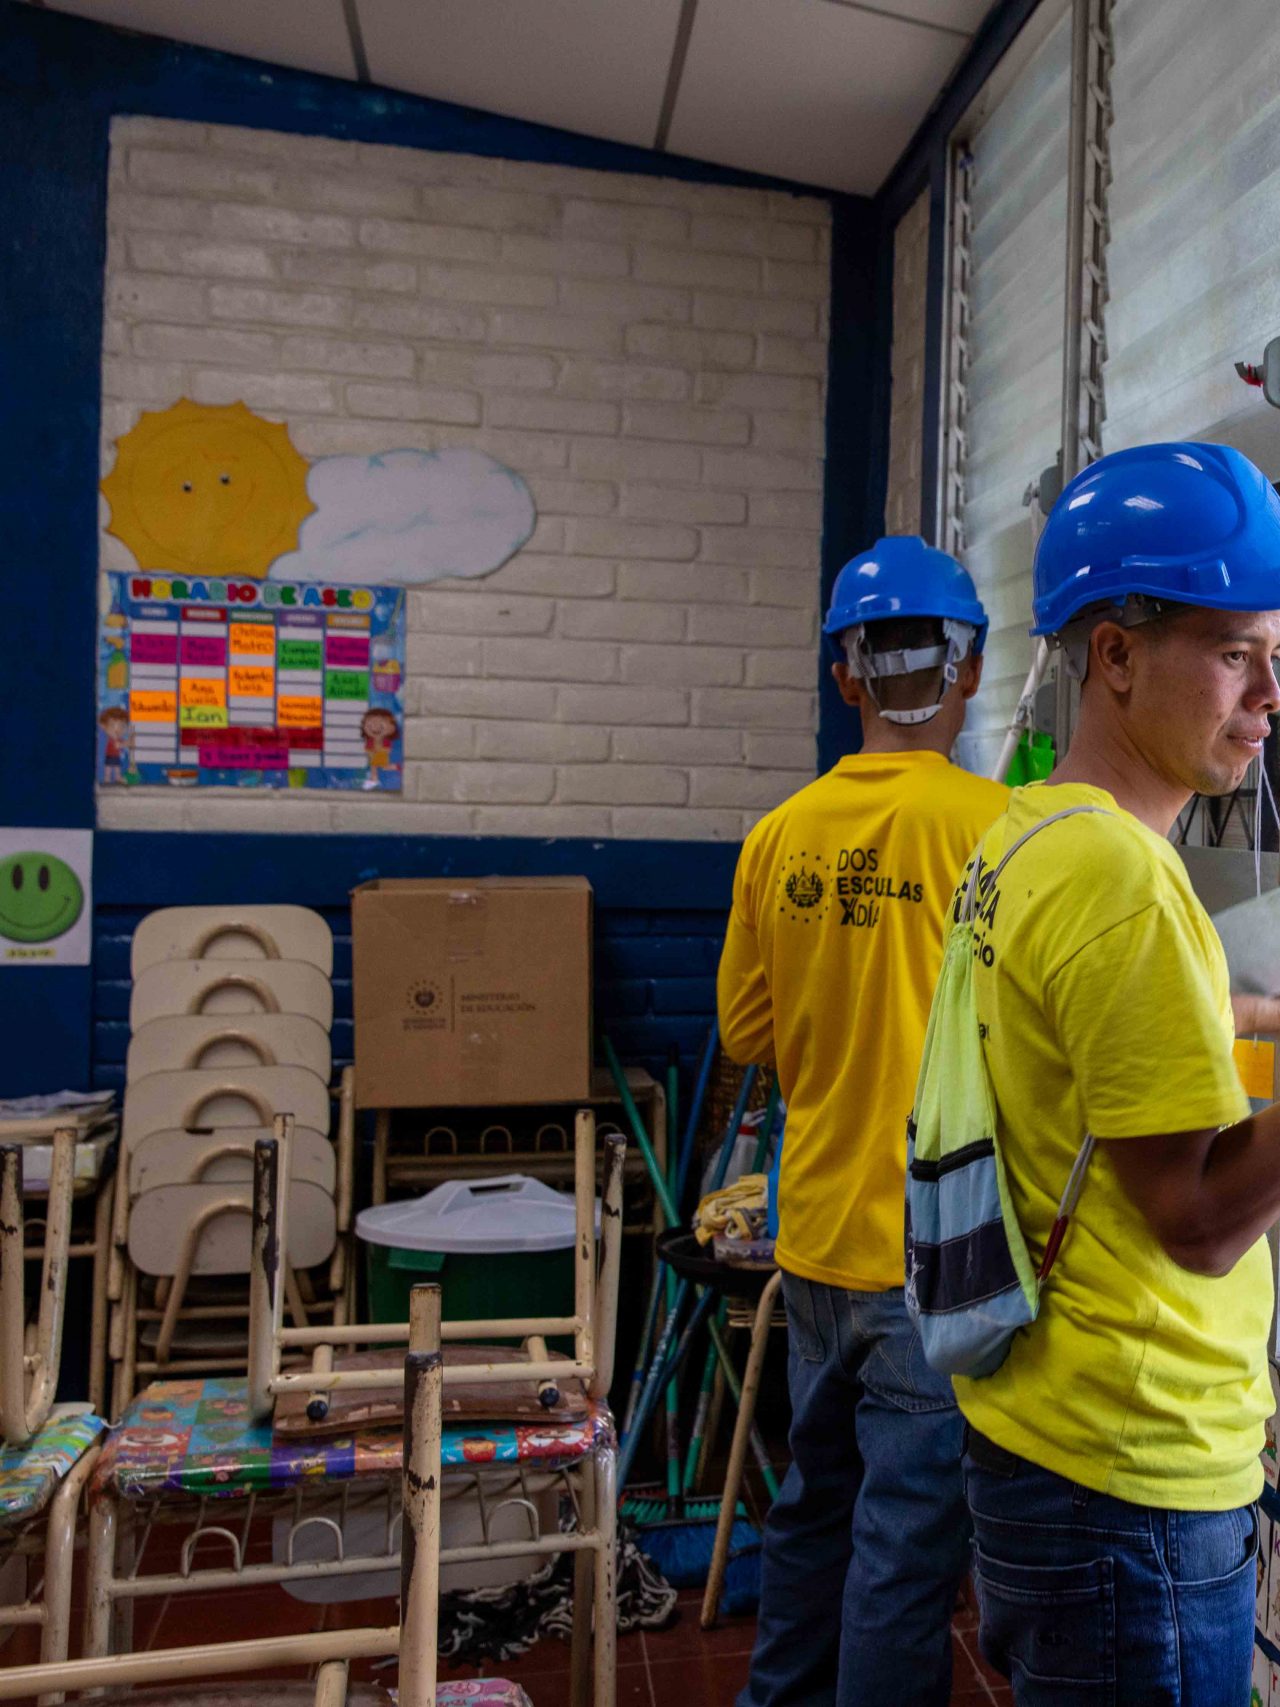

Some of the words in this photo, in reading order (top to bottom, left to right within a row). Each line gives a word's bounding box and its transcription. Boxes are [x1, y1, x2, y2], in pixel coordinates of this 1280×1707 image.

[132, 578, 257, 603] HORARIO
[264, 584, 297, 605] DE
[303, 587, 373, 609] ASEO
[185, 706, 223, 723] Ian
[837, 848, 878, 872] DOS
[1272, 1672, 1278, 1692] r
